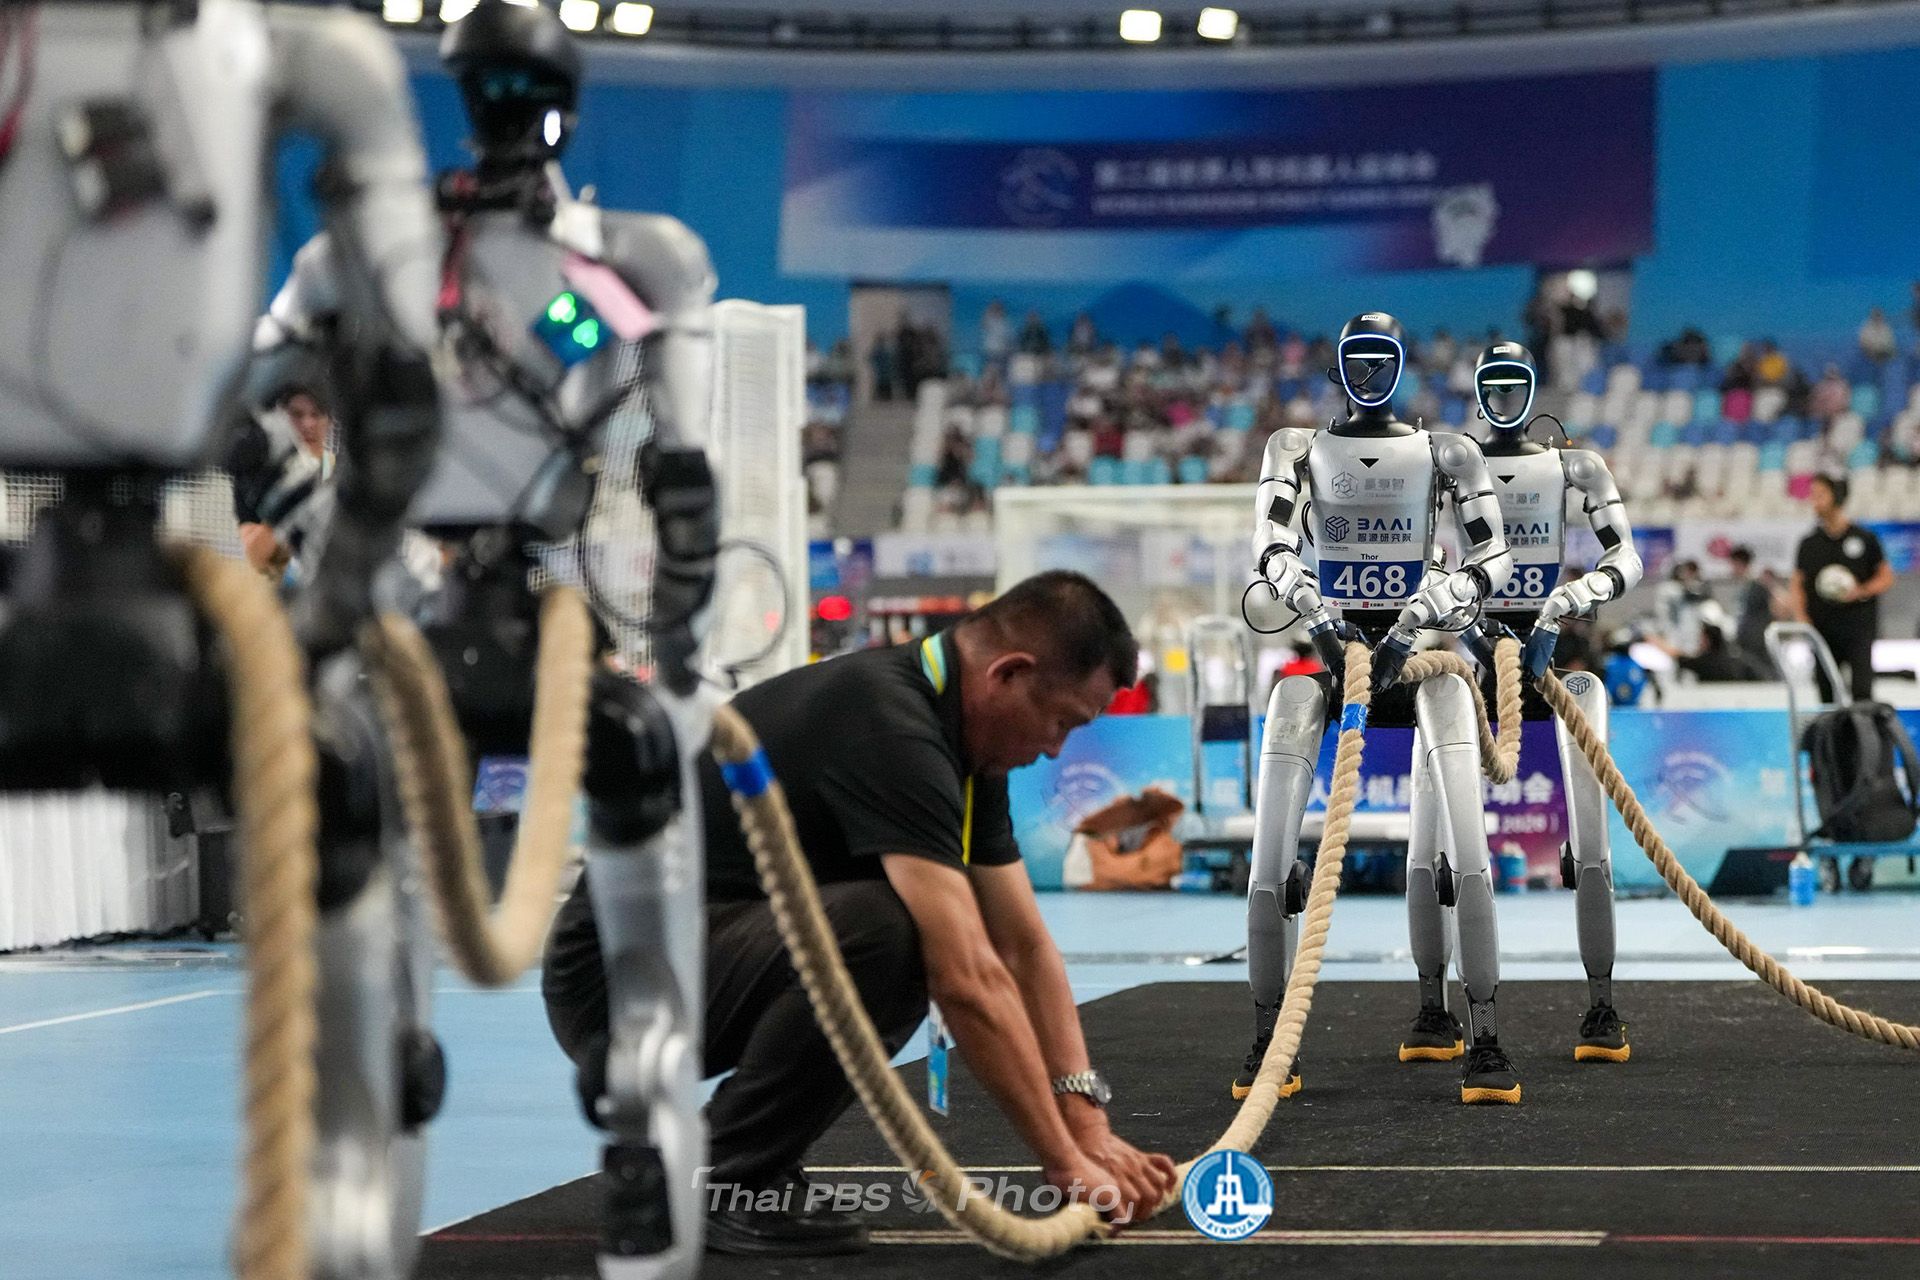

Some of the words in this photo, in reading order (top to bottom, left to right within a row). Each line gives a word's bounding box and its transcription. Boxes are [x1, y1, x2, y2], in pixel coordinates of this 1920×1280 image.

[1357, 518, 1412, 531] BAAI
[1361, 553, 1379, 561] Thor
[1333, 565, 1407, 598] 468
[1501, 566, 1544, 598] 68
